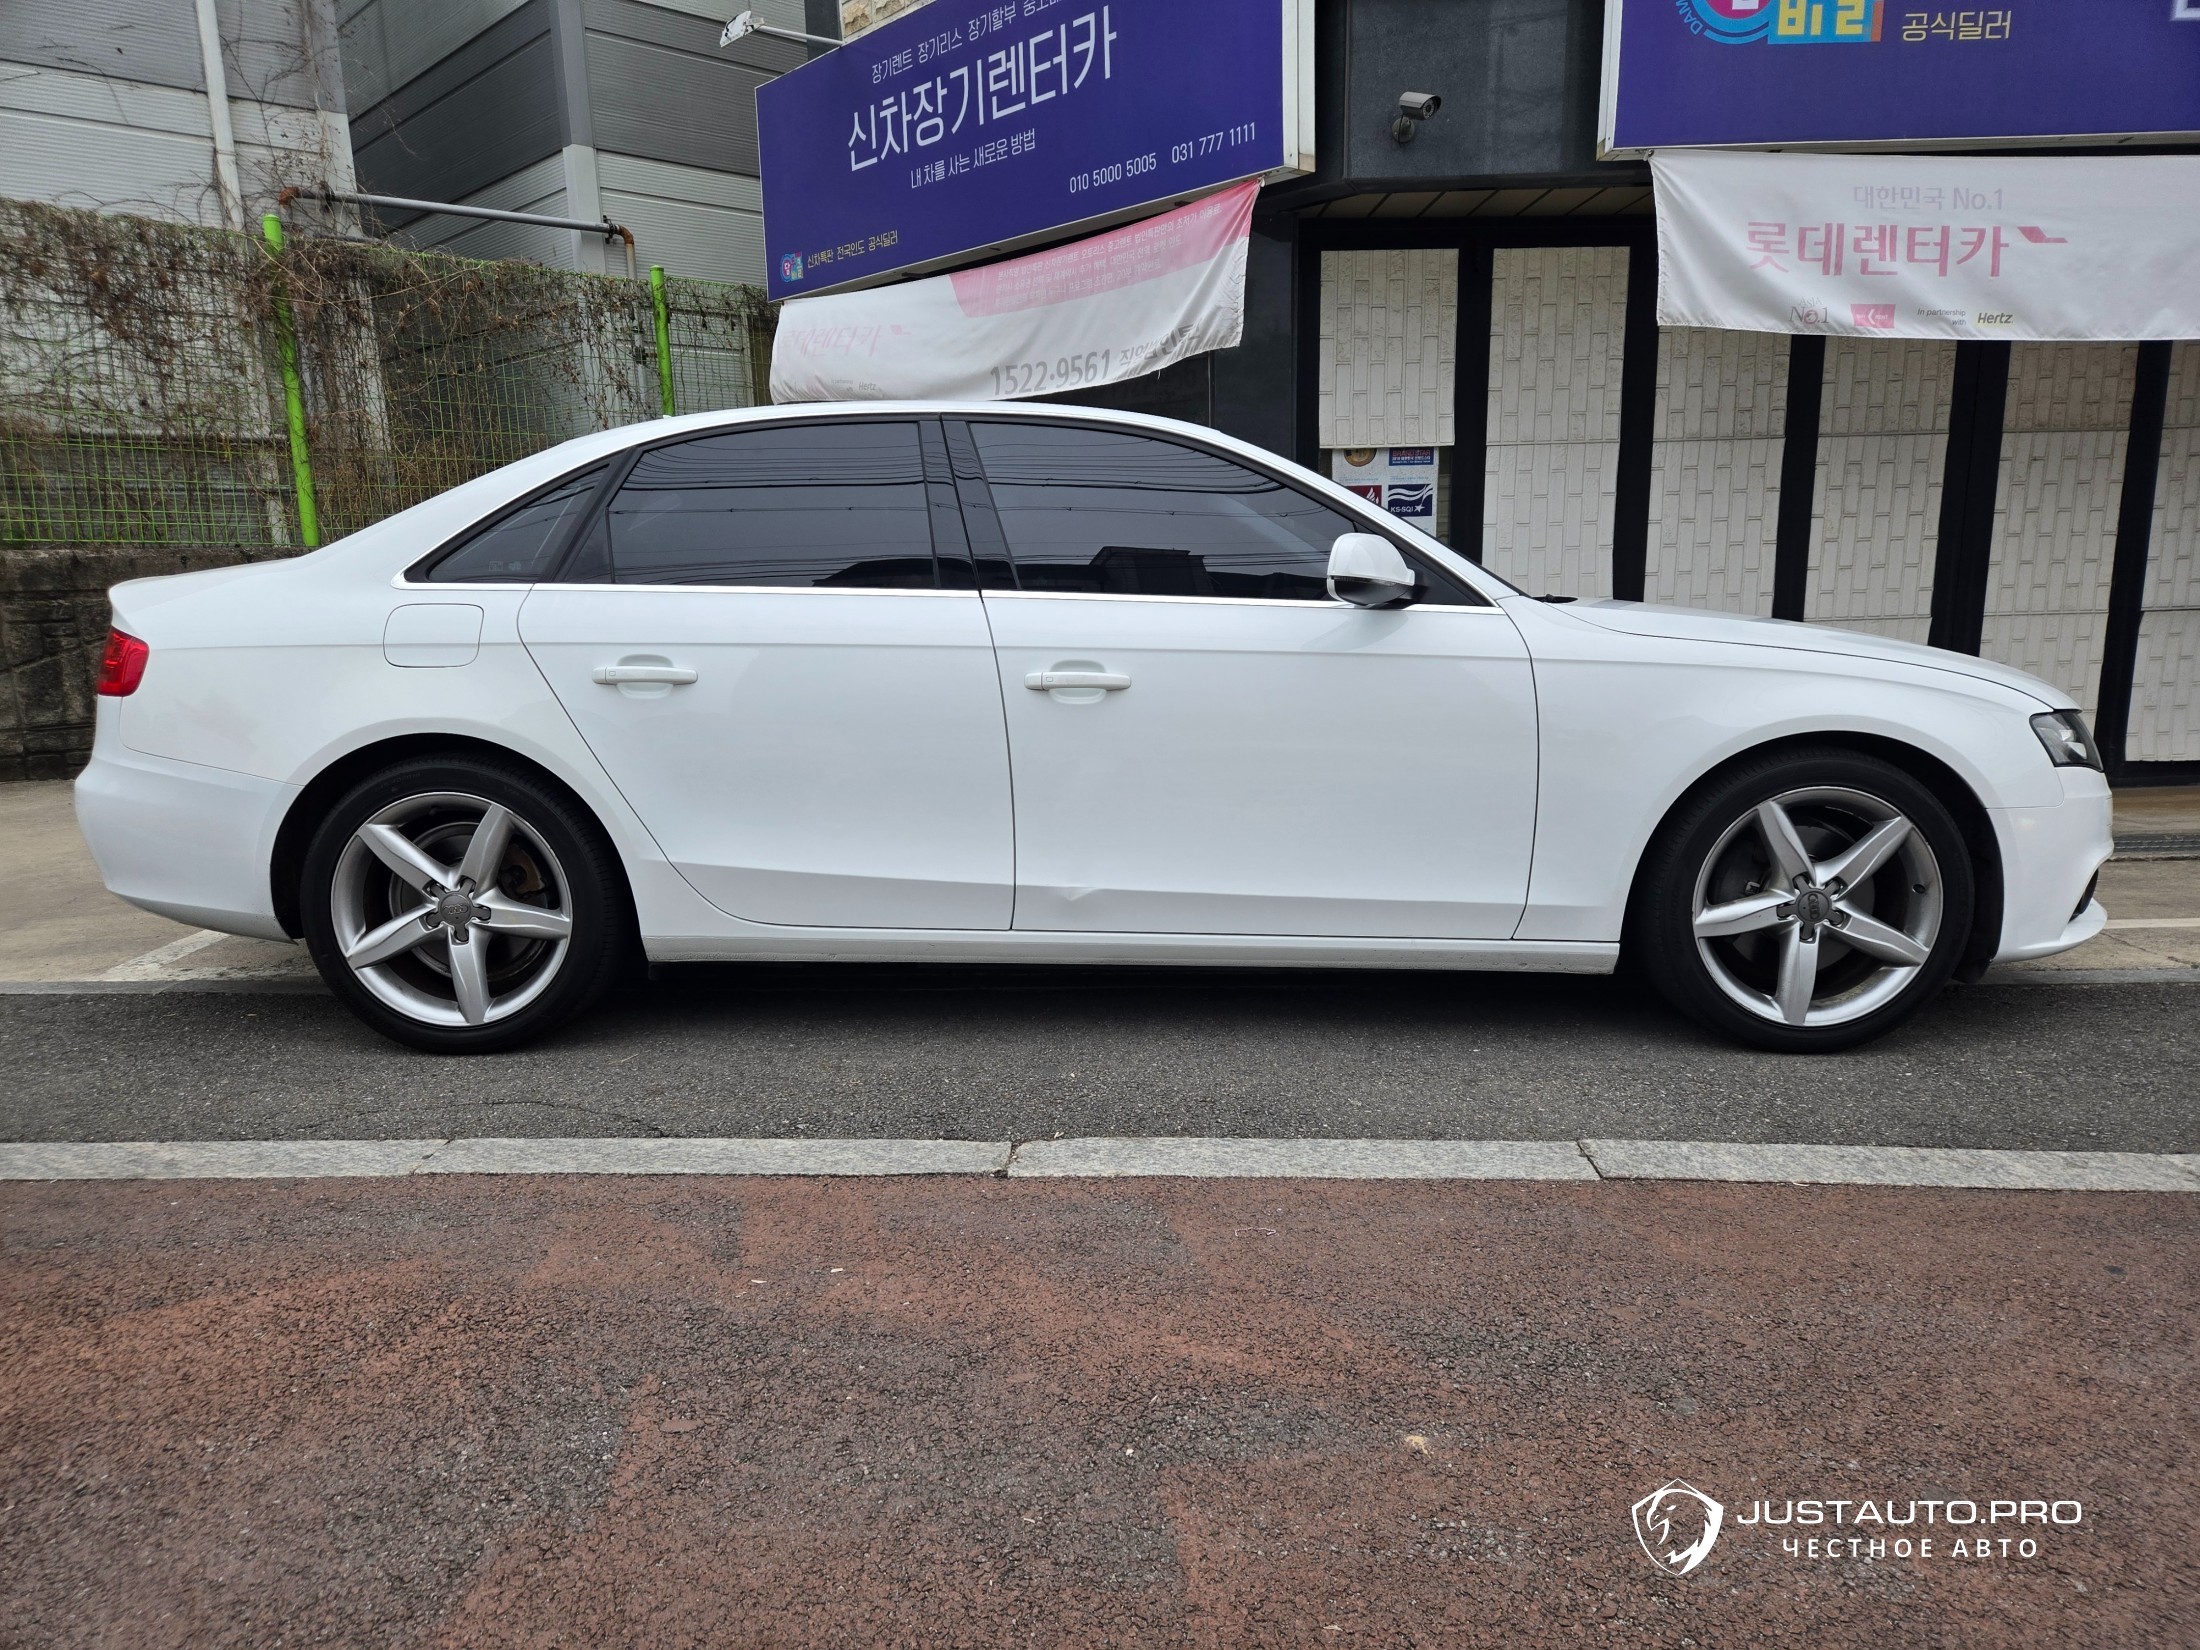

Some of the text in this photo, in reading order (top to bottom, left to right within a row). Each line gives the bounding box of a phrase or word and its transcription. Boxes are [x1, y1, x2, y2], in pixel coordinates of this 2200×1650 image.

[872, 48, 914, 84] 장기렌트
[918, 27, 963, 64] 장기리스
[968, 6, 1017, 41] 장기할부
[1902, 10, 2012, 42] 공식딜러
[848, 4, 1117, 172] 신차장기렌터카
[910, 127, 1036, 189] 내 차를 사는 새로운 방법
[1069, 121, 1256, 193] 010 5000 5005 031 777 1111
[1853, 185, 2004, 211] 대한민국 No.1
[837, 240, 866, 261] 전국인도
[868, 229, 898, 252] 공식딜러
[1746, 221, 2010, 278] 롯데렌터카
[1917, 308, 1966, 317] In partnership
[858, 381, 877, 391] Hertz
